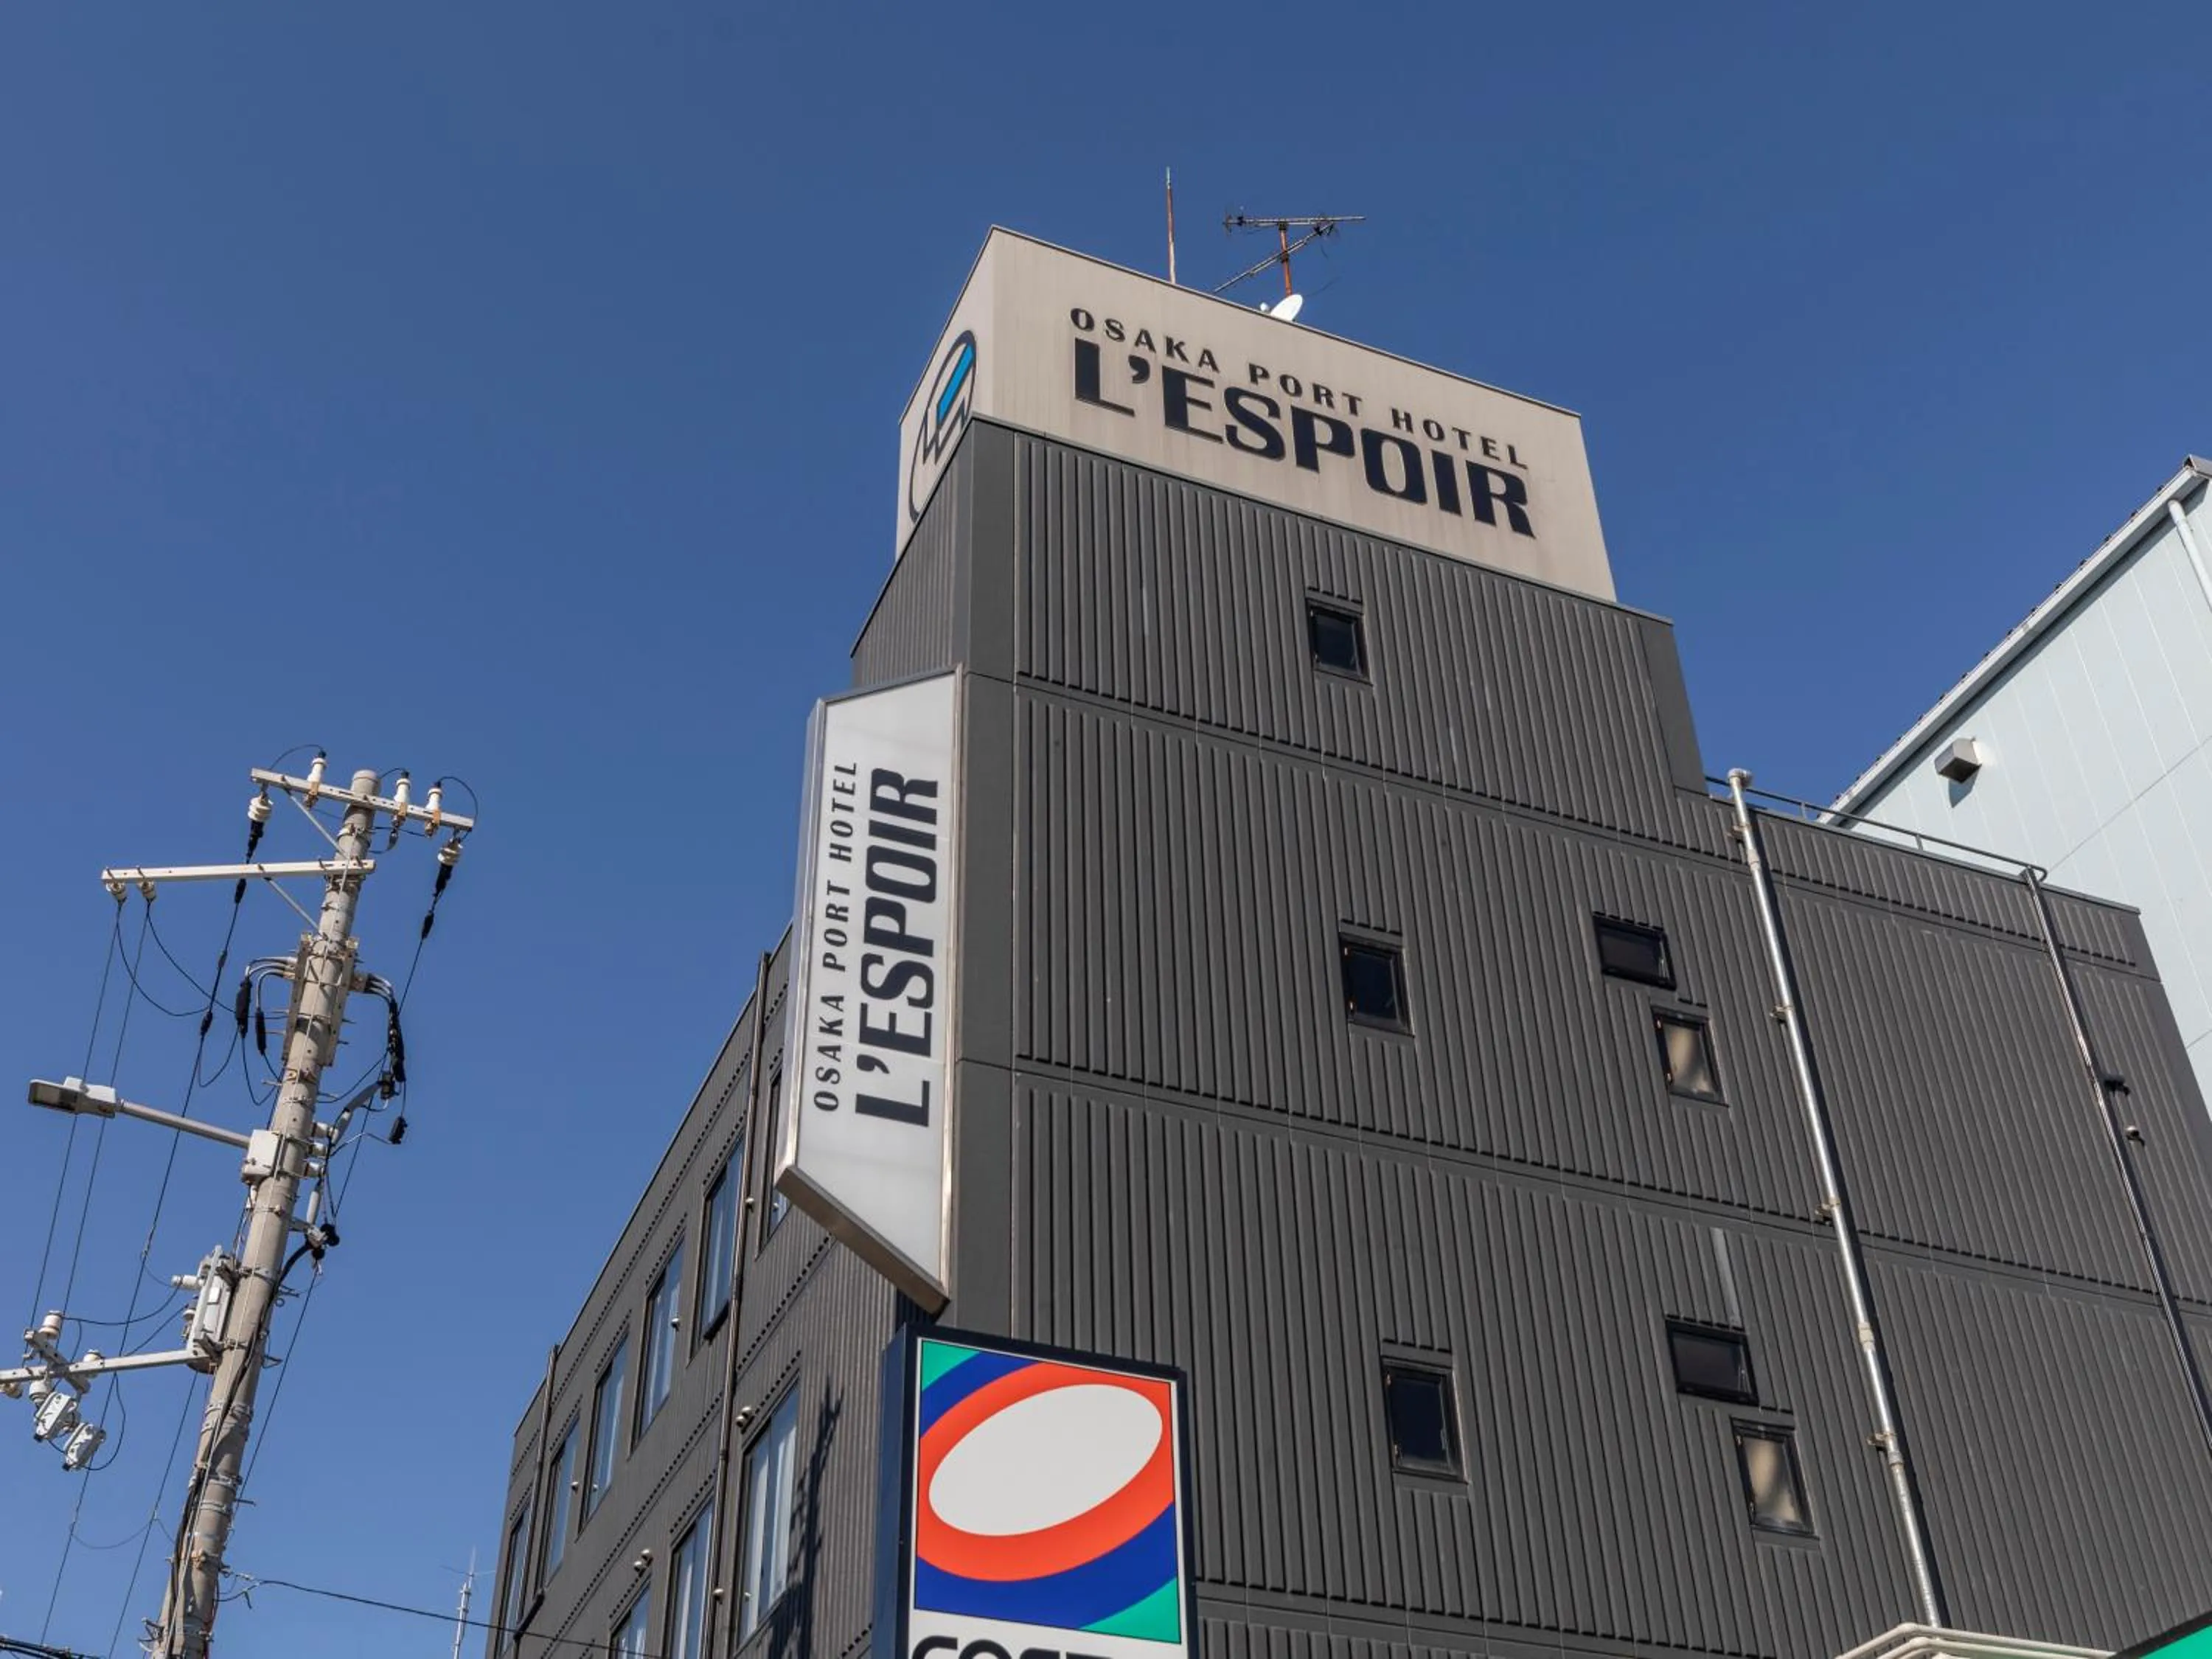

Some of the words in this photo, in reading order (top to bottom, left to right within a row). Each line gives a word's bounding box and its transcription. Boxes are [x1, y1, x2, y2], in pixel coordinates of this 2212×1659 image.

[1070, 307, 1220, 373] OSAKA
[1248, 362, 1363, 417] PORT
[1391, 407, 1528, 470] HOTEL
[1074, 337, 1537, 540] L'ESPOIR
[829, 762, 858, 863] HOTEL
[822, 880, 851, 973] PORT
[855, 767, 939, 1127] L'ESPOIR
[813, 994, 845, 1112] OSAKA
